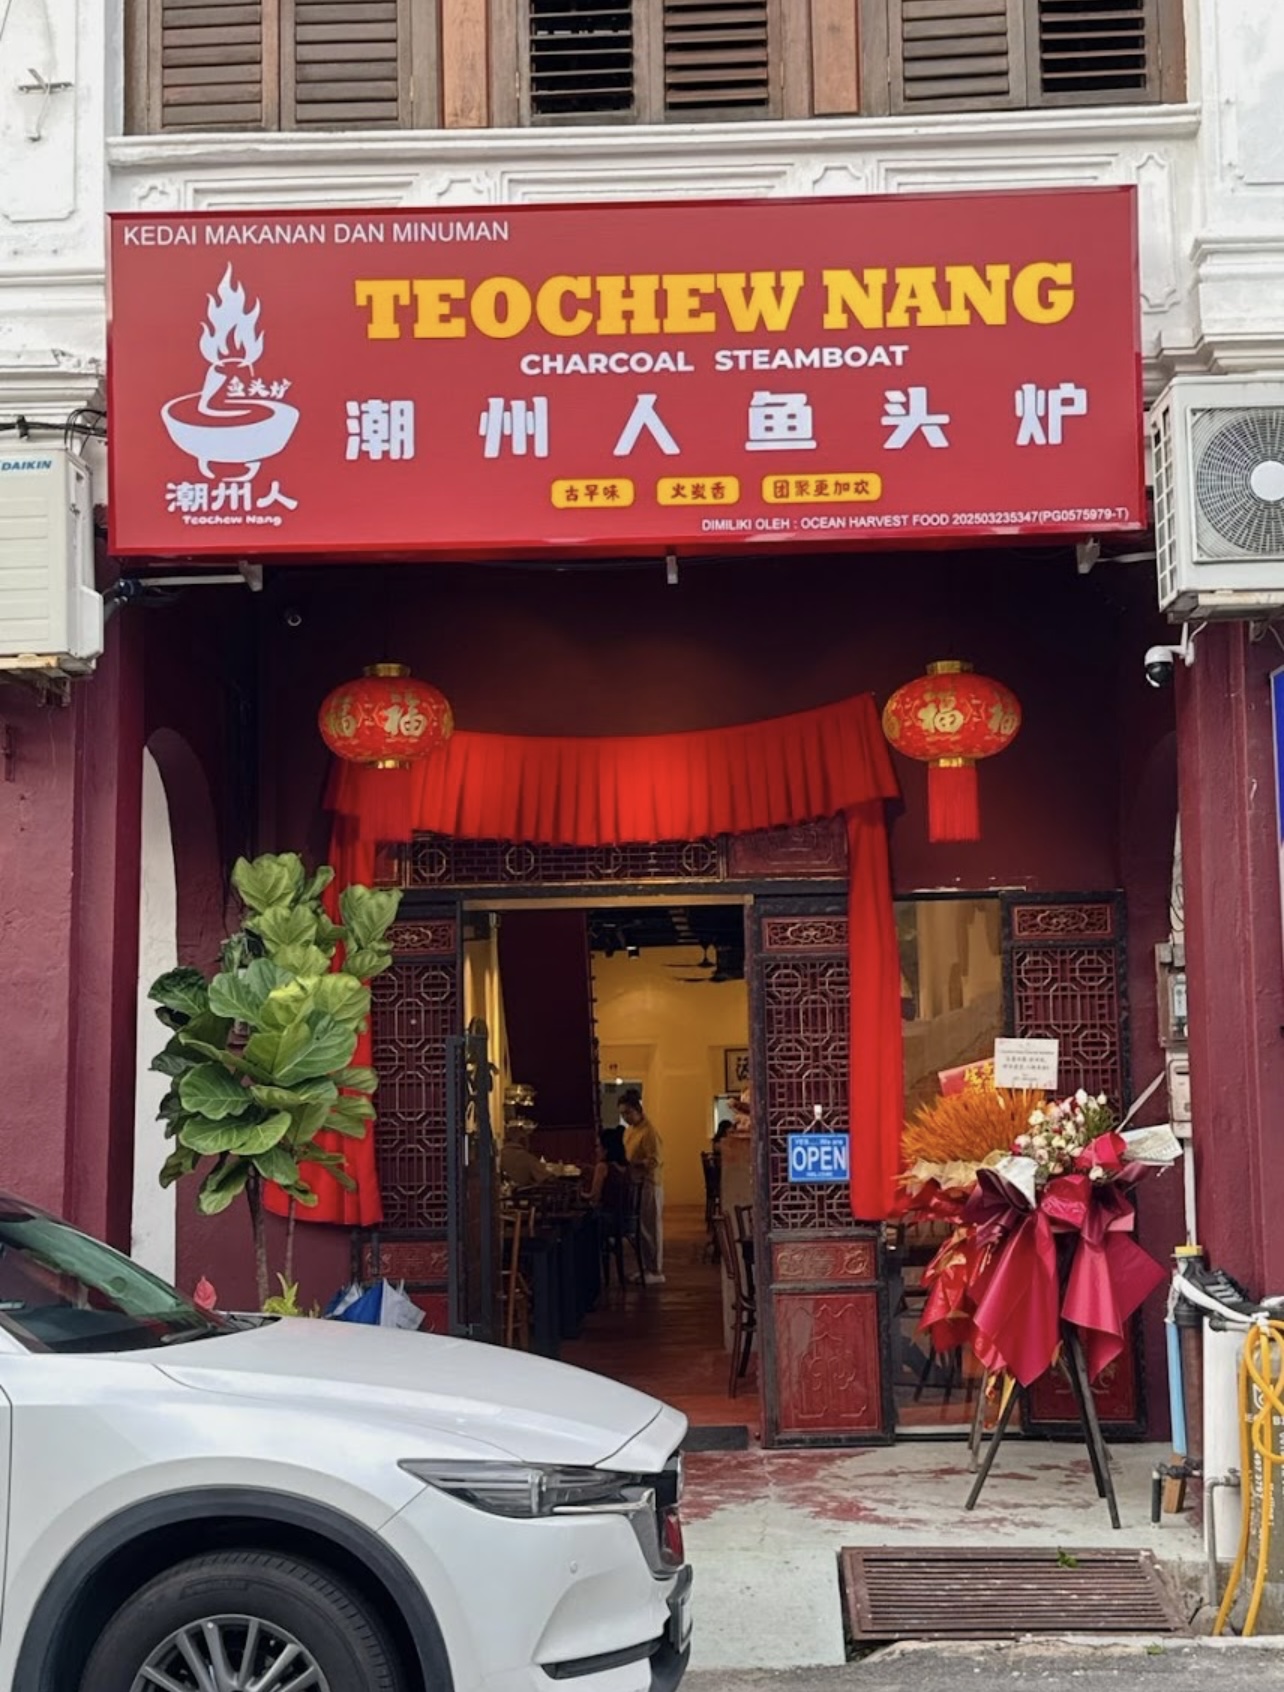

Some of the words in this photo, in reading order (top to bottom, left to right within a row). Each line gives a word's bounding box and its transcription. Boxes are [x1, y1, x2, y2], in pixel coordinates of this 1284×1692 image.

[123, 225, 197, 246] KEDAI
[204, 223, 326, 246] MAKANAN
[333, 222, 385, 244] DAN
[392, 220, 510, 243] MINUMAN
[354, 270, 804, 340] TEOCHEW
[822, 261, 1075, 330] NANG
[519, 351, 695, 377] CHARCOAL
[714, 345, 909, 372] STEAMBOAT
[1, 460, 52, 471] DAIKIN
[165, 480, 299, 513] 潮州人
[565, 484, 621, 502] 古早味
[182, 515, 243, 525] Teochew
[245, 515, 282, 526] Nang
[702, 518, 752, 531] DIMILIKI
[755, 518, 790, 530] OLEH
[801, 517, 847, 529] OCEAN
[849, 515, 909, 528] HARVEST
[912, 514, 949, 526] FOOD
[917, 690, 964, 733] 福
[792, 1146, 847, 1172] OPEN
